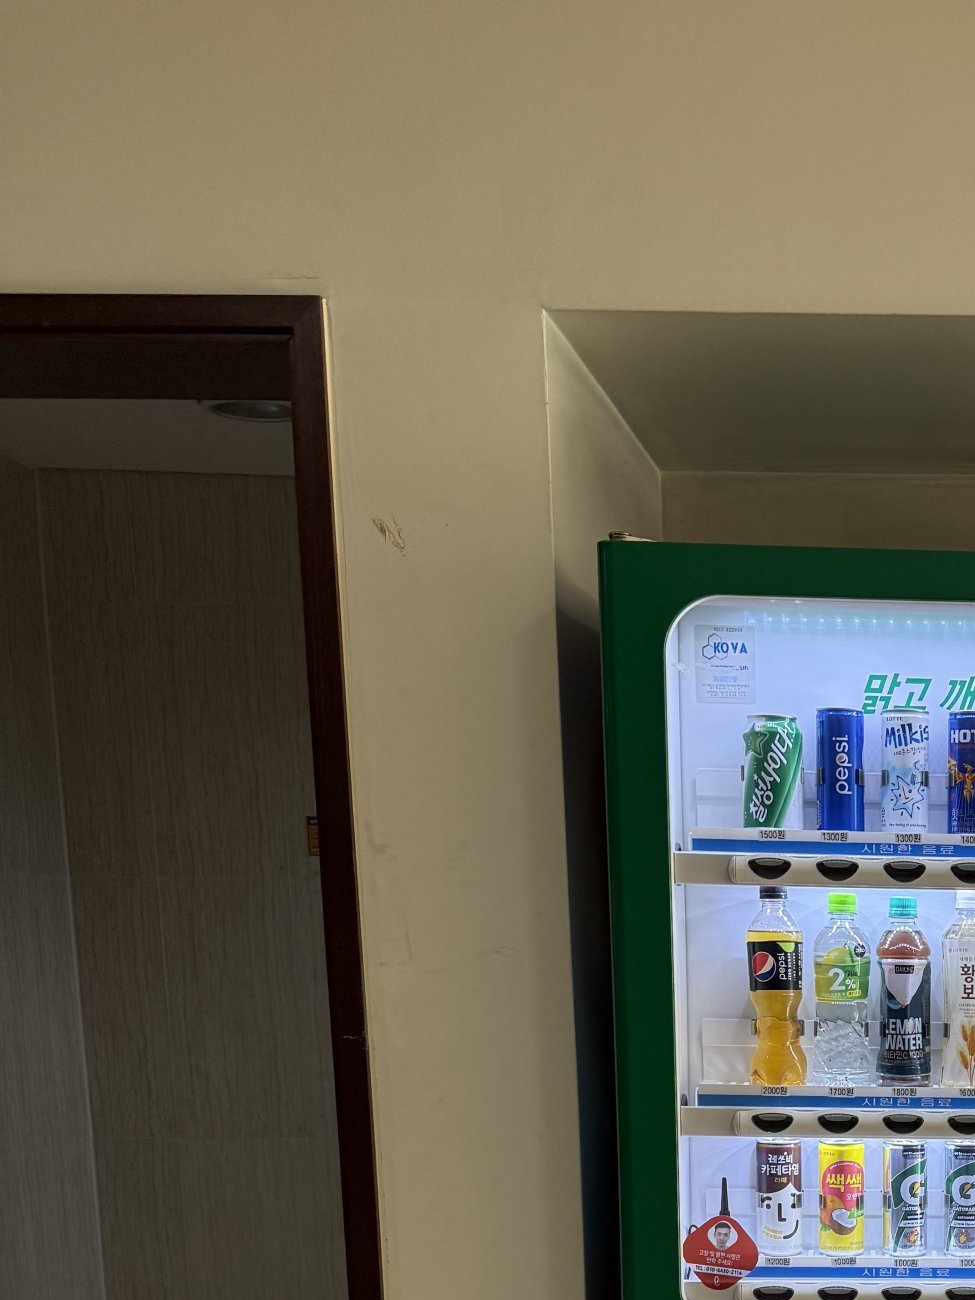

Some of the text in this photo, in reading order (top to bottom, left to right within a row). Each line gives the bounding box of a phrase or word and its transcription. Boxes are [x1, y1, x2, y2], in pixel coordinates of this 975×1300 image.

[713, 641, 748, 654] KOVA
[861, 673, 933, 715] 맑고
[885, 723, 929, 748] Milkis
[833, 735, 852, 795] pepsi
[760, 830, 785, 839] 1500원
[822, 832, 848, 841] 1300원
[896, 834, 921, 843] 1300원
[861, 844, 954, 854] 시원한 음료
[777, 953, 787, 980] pepsi
[886, 1017, 922, 1034] LEMON
[885, 1034, 922, 1050] WATER
[763, 1087, 787, 1095] 2000원
[830, 1088, 854, 1096] 1700원
[862, 1097, 952, 1107] 시원한 음료
[768, 1152, 793, 1164] 레쓰비
[761, 1164, 799, 1176] 카페타임
[767, 1257, 790, 1265] 1200원
